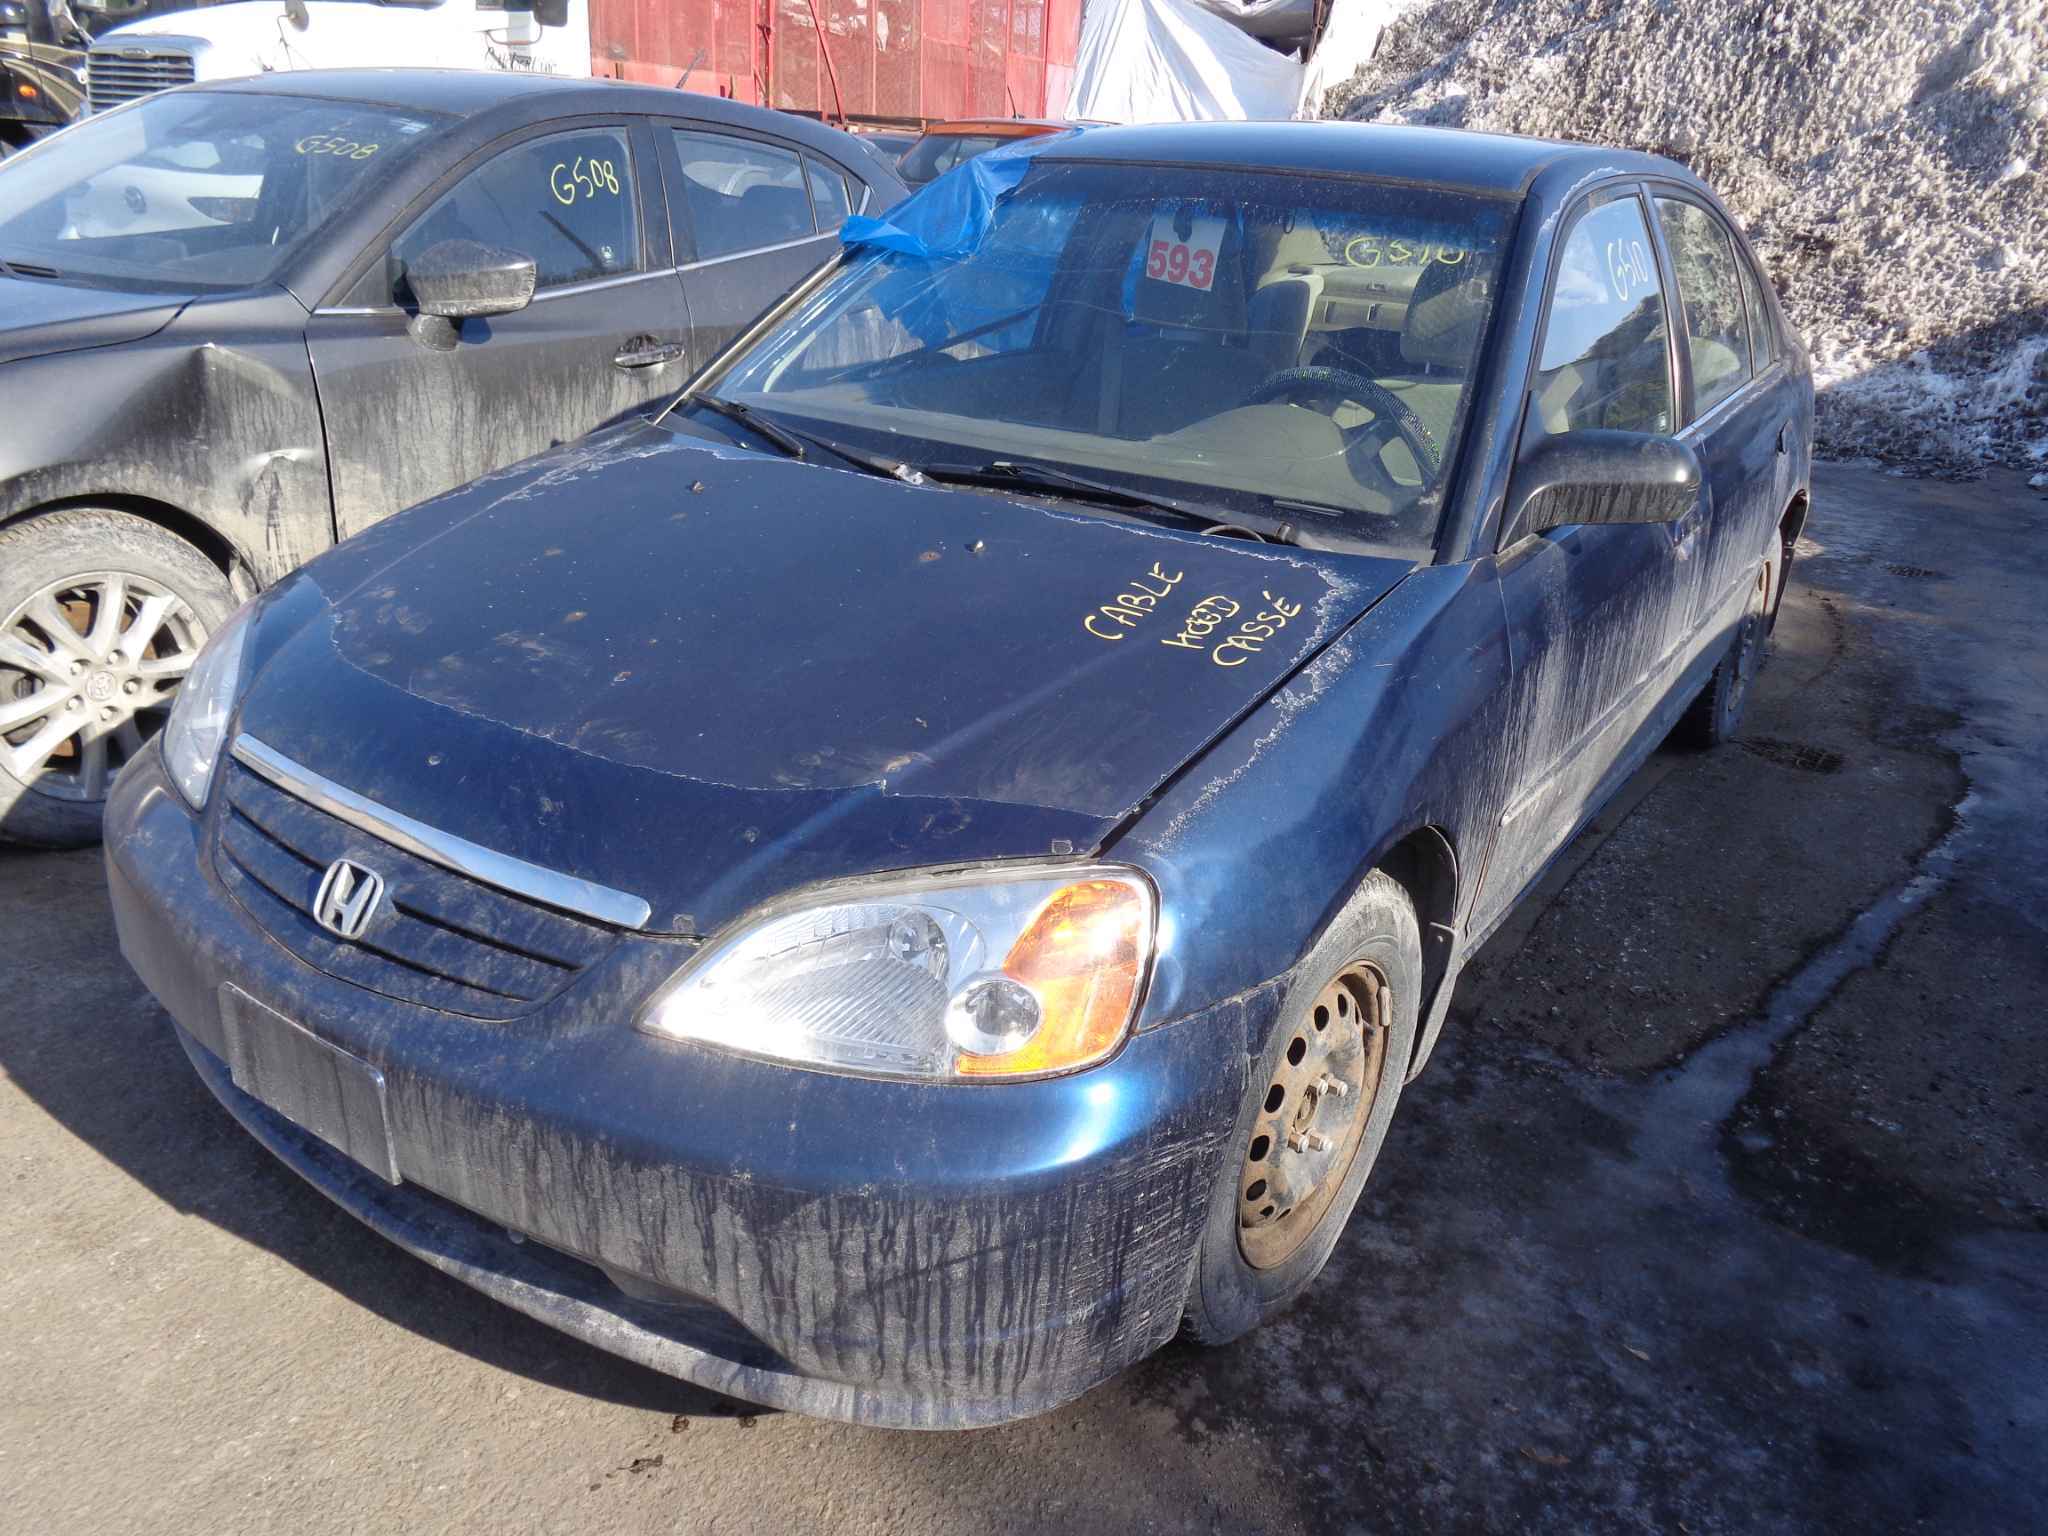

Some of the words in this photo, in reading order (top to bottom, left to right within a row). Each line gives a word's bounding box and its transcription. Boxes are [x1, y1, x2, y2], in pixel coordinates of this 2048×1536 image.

[296, 135, 379, 159] G508
[551, 156, 619, 205] G508
[1148, 240, 1214, 288] 593
[1084, 561, 1184, 640] CABLE
